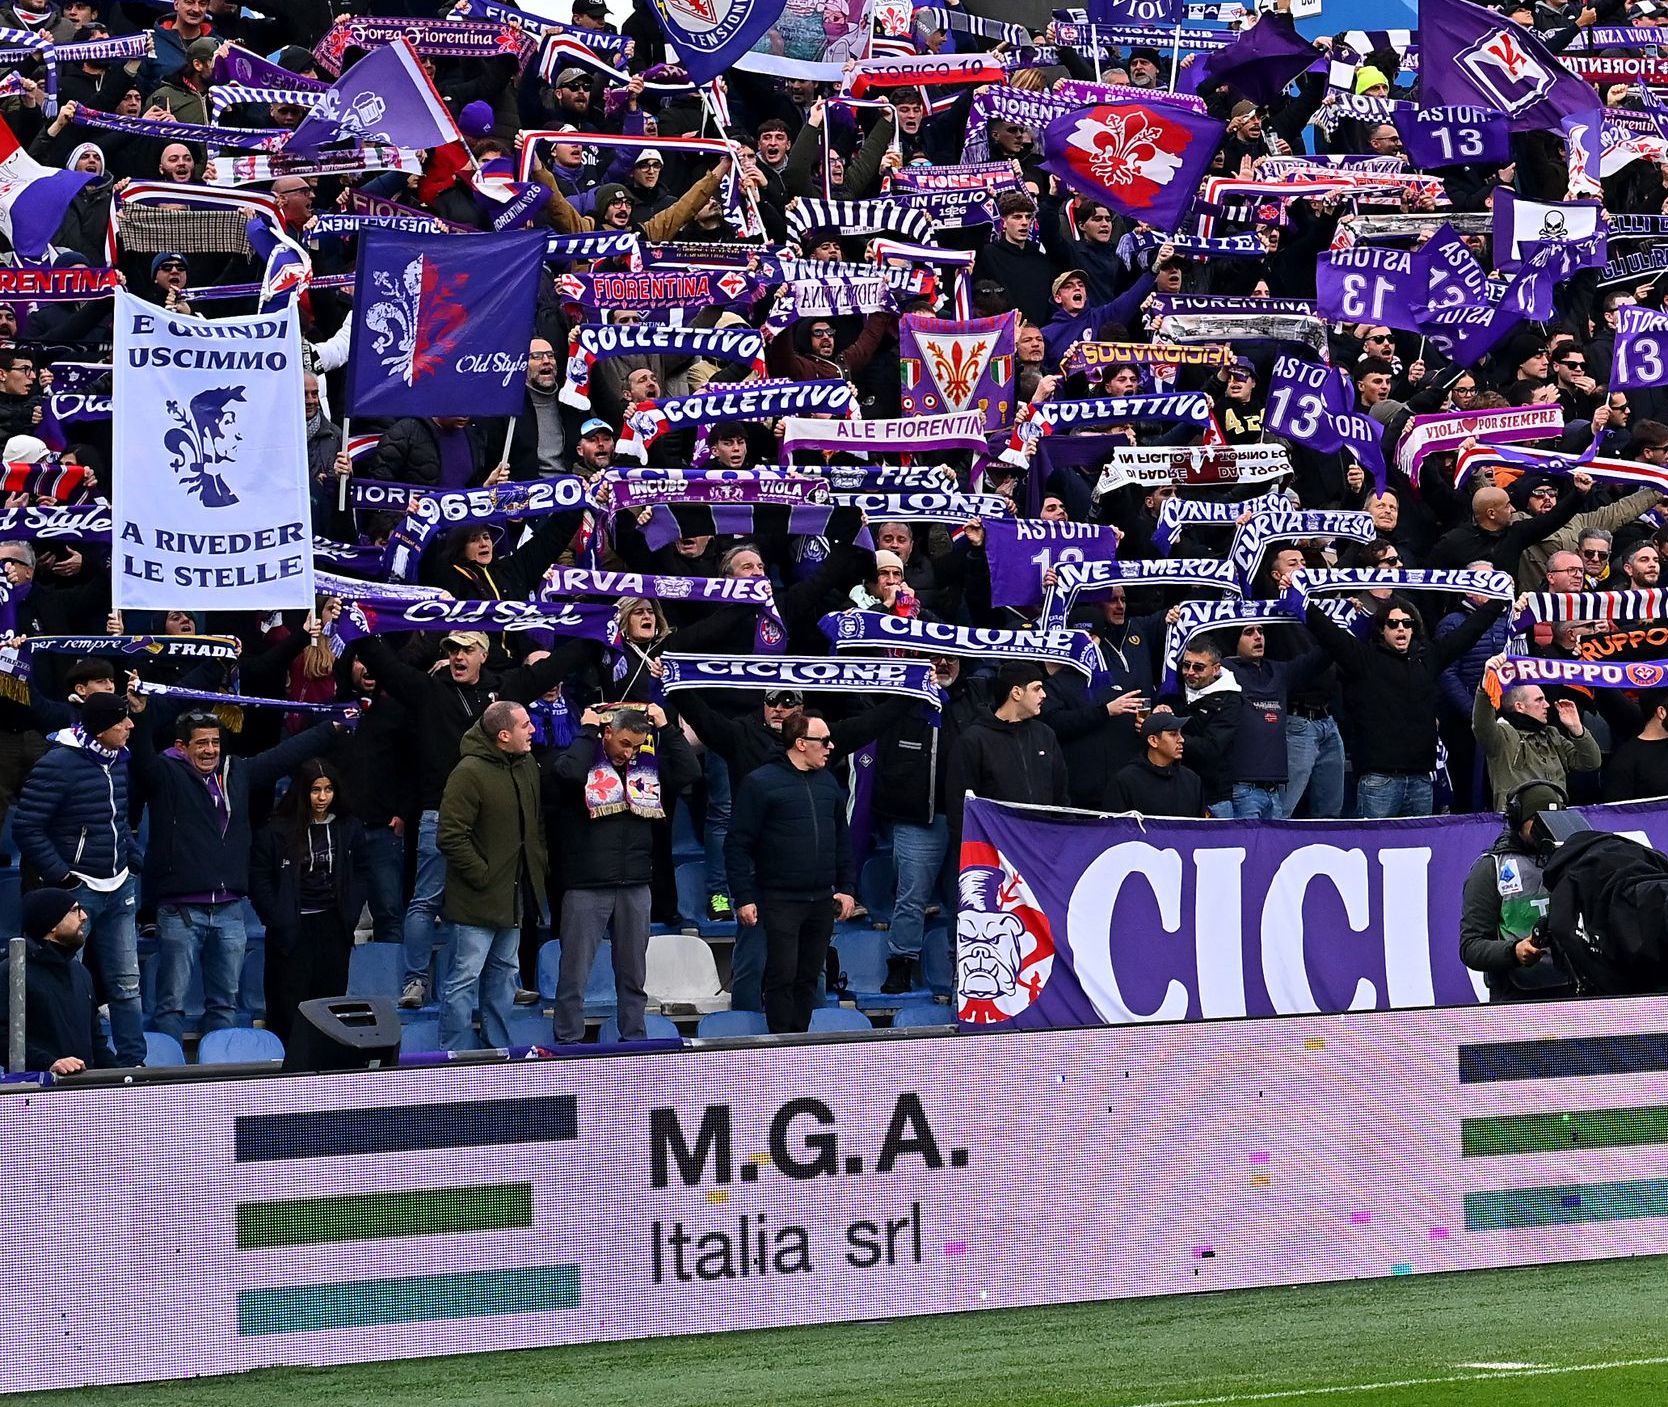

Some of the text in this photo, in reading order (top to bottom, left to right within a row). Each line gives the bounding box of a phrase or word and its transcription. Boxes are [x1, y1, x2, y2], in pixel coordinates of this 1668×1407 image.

[351, 22, 493, 48] Forza Fiorentina
[1431, 128, 1484, 158] 13
[594, 273, 710, 301] FIORENTINA
[132, 315, 288, 339] E QUINDI
[582, 326, 763, 360] COLLETTIVO
[128, 347, 287, 371] USCIMMO
[456, 353, 529, 387] Old Style
[1617, 341, 1665, 383] 13
[663, 385, 850, 423] COLLETTIVO
[1044, 391, 1208, 424] COLLETTIVO
[1270, 387, 1323, 439] 13
[1425, 409, 1557, 440] VIOLA POR SIEMPRE
[628, 478, 802, 496] INCUBO VIOLA
[120, 521, 305, 553] A RIVEDER
[122, 554, 305, 588] LE STELLE
[404, 600, 488, 626] Old
[880, 615, 1074, 651] CICLONE
[696, 660, 908, 685] CICLONE
[1499, 656, 1623, 683] GRUPPO
[649, 1091, 971, 1188] M.G.A.
[651, 1199, 924, 1283] Italia srl
